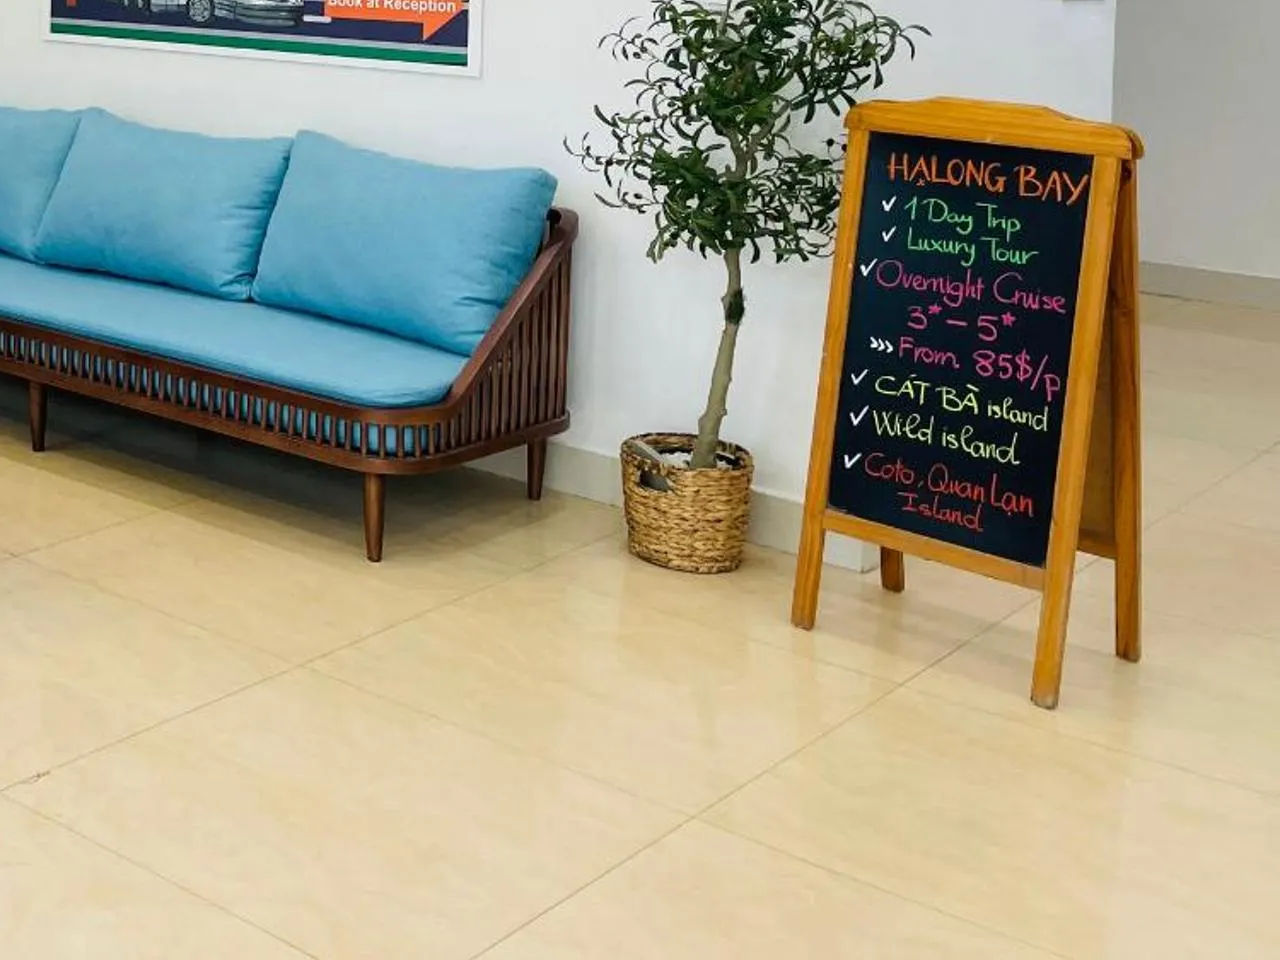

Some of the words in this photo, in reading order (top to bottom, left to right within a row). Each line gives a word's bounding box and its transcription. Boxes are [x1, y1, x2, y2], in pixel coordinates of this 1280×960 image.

[1014, 164, 1089, 206] BAY
[904, 195, 918, 220] 1
[921, 197, 974, 235] Day
[975, 201, 1022, 243] Trip
[907, 227, 976, 267] Luxury
[980, 236, 1039, 265] Tour
[876, 259, 985, 308] Overnight
[993, 271, 1067, 314] Cruise
[987, 397, 1049, 432] island
[873, 410, 935, 445] Wild
[941, 425, 1020, 465] island
[928, 463, 984, 503] Quan
[897, 491, 984, 533] Island
